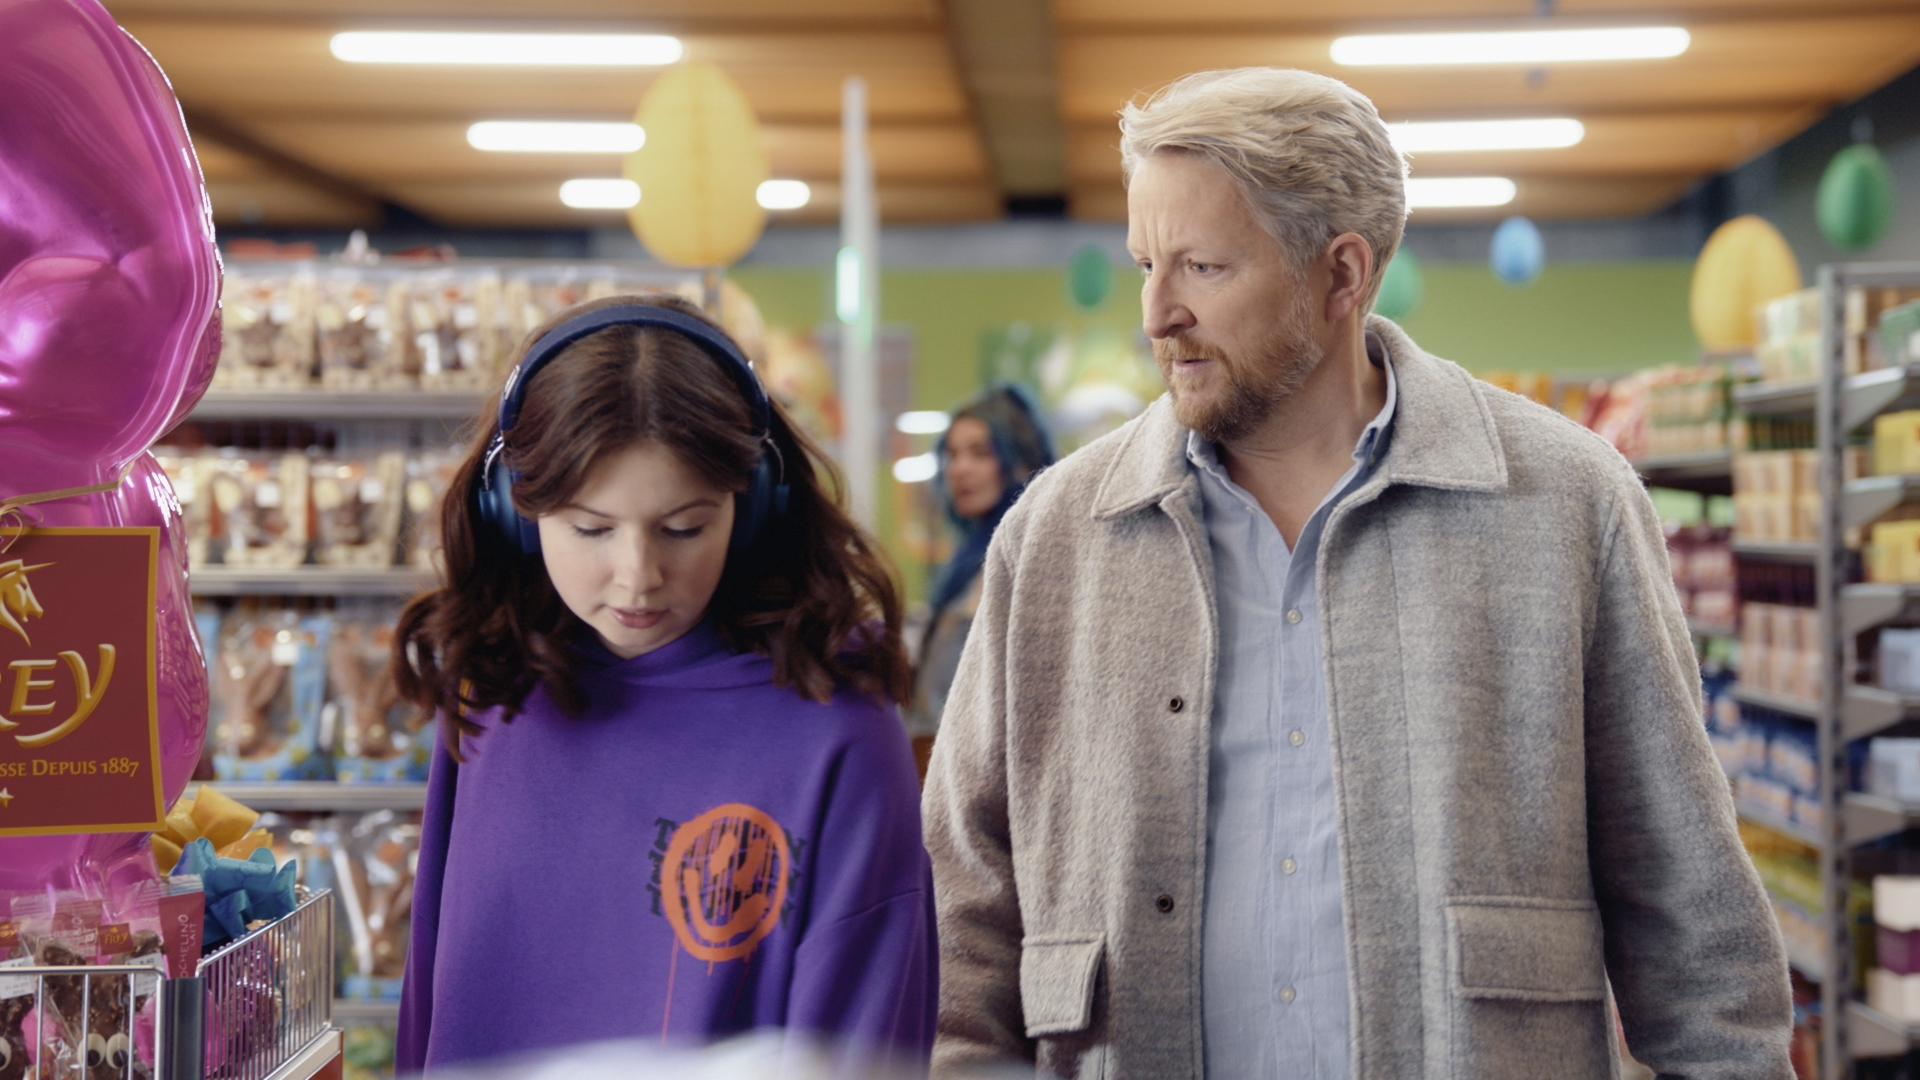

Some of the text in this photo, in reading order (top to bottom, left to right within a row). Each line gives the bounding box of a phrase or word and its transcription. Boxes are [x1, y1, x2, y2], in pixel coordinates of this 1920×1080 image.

[0, 644, 116, 748] EY
[32, 758, 97, 776] DEPUIS
[100, 757, 139, 778] 1887
[189, 923, 197, 947] LAIT
